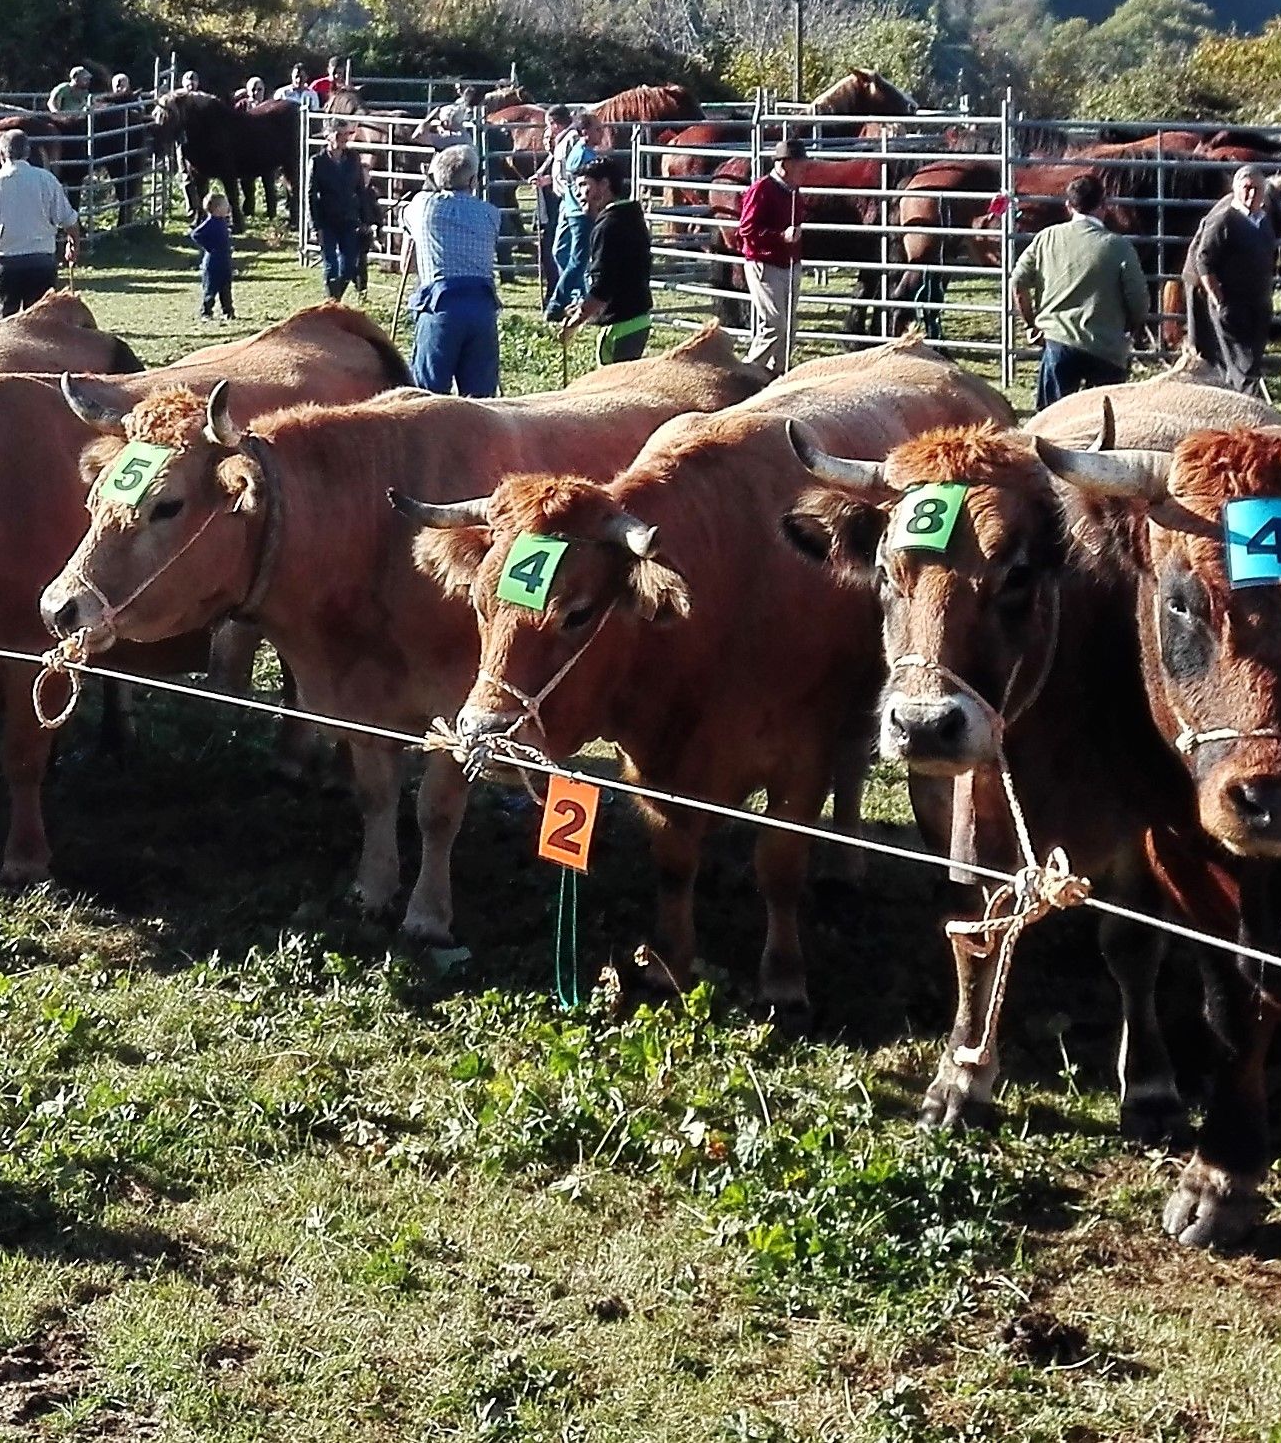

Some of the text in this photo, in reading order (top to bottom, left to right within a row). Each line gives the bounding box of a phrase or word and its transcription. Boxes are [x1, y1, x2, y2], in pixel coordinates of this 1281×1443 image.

[114, 457, 152, 491] 5
[906, 498, 948, 534] 8
[509, 550, 550, 594] 4
[547, 799, 586, 855] 2
